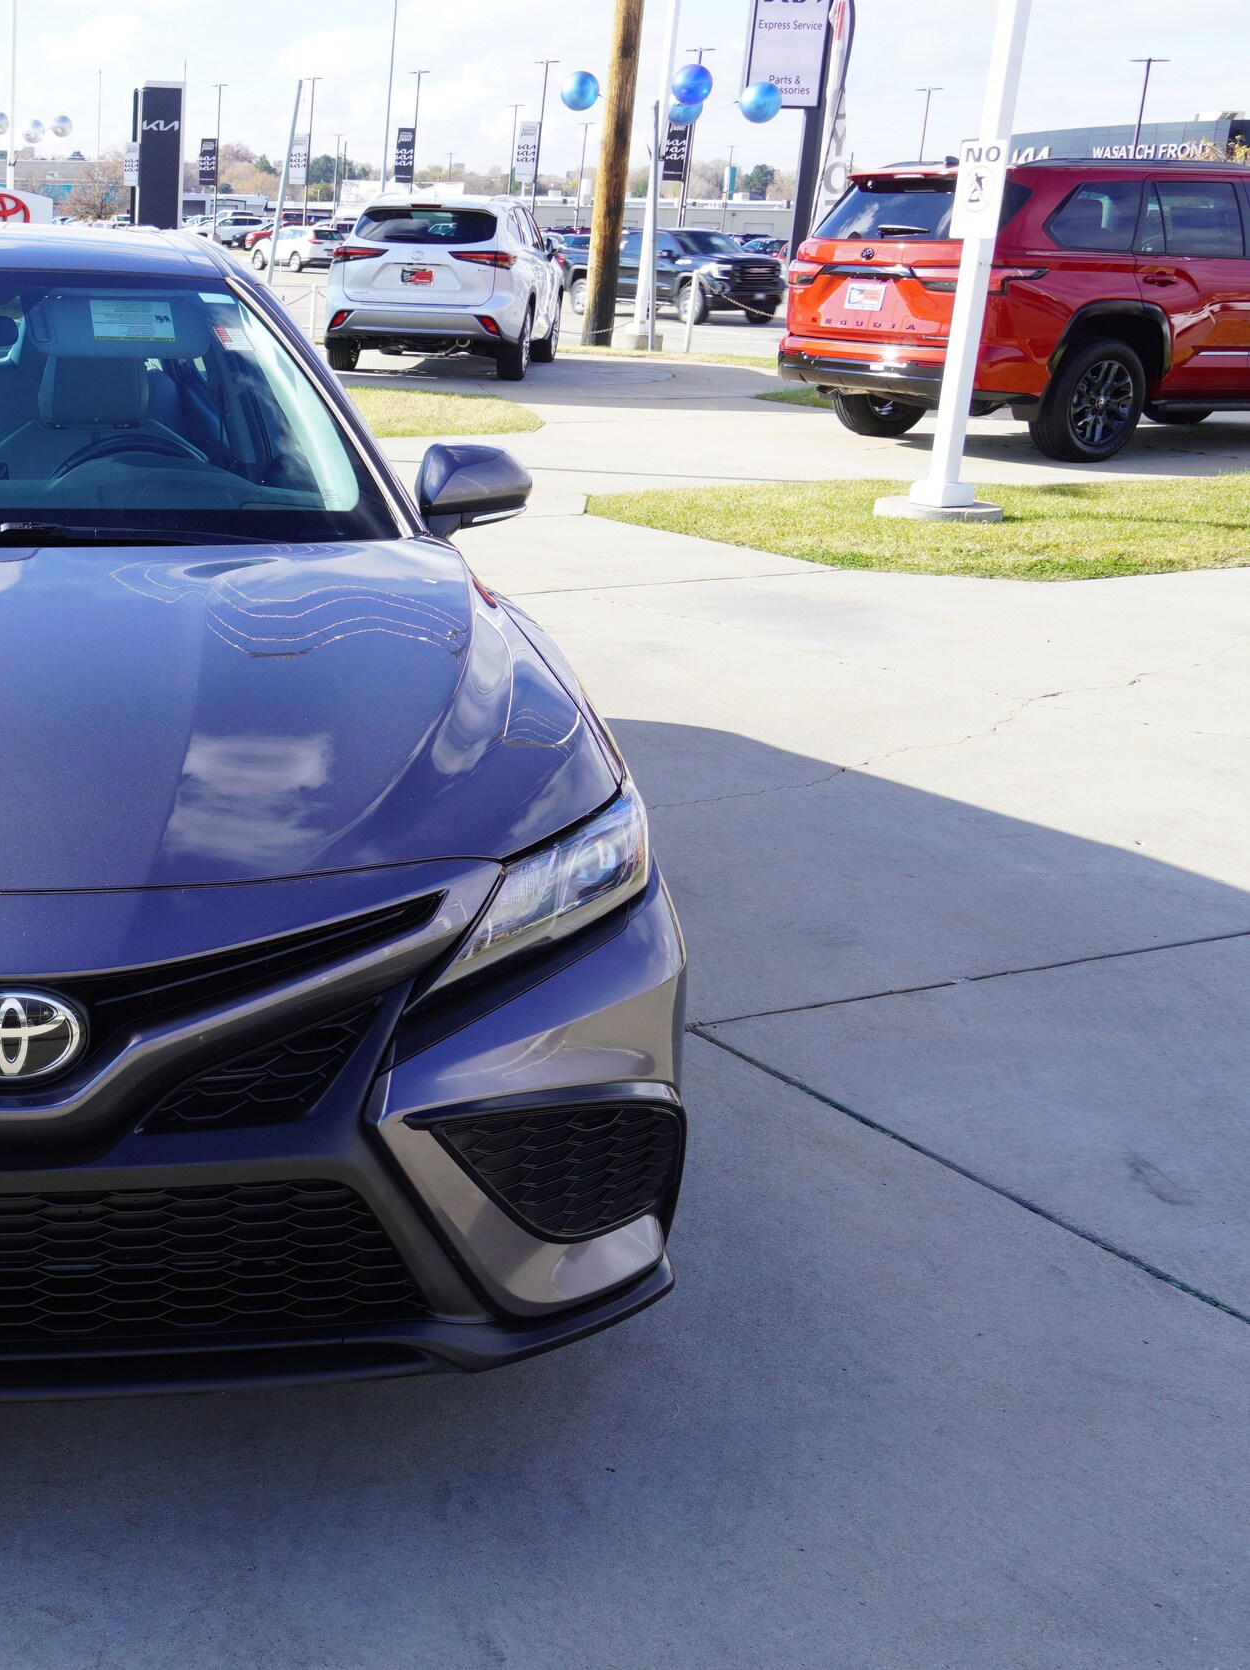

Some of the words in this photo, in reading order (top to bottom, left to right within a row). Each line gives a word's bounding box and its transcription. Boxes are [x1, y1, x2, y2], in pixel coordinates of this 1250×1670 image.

[759, 20, 791, 31] Express
[793, 20, 823, 31] Service
[769, 75, 792, 85] Parts
[794, 75, 801, 85] &
[779, 86, 810, 95] ssories
[965, 146, 1000, 162] NO
[1092, 144, 1156, 159] WASATCH
